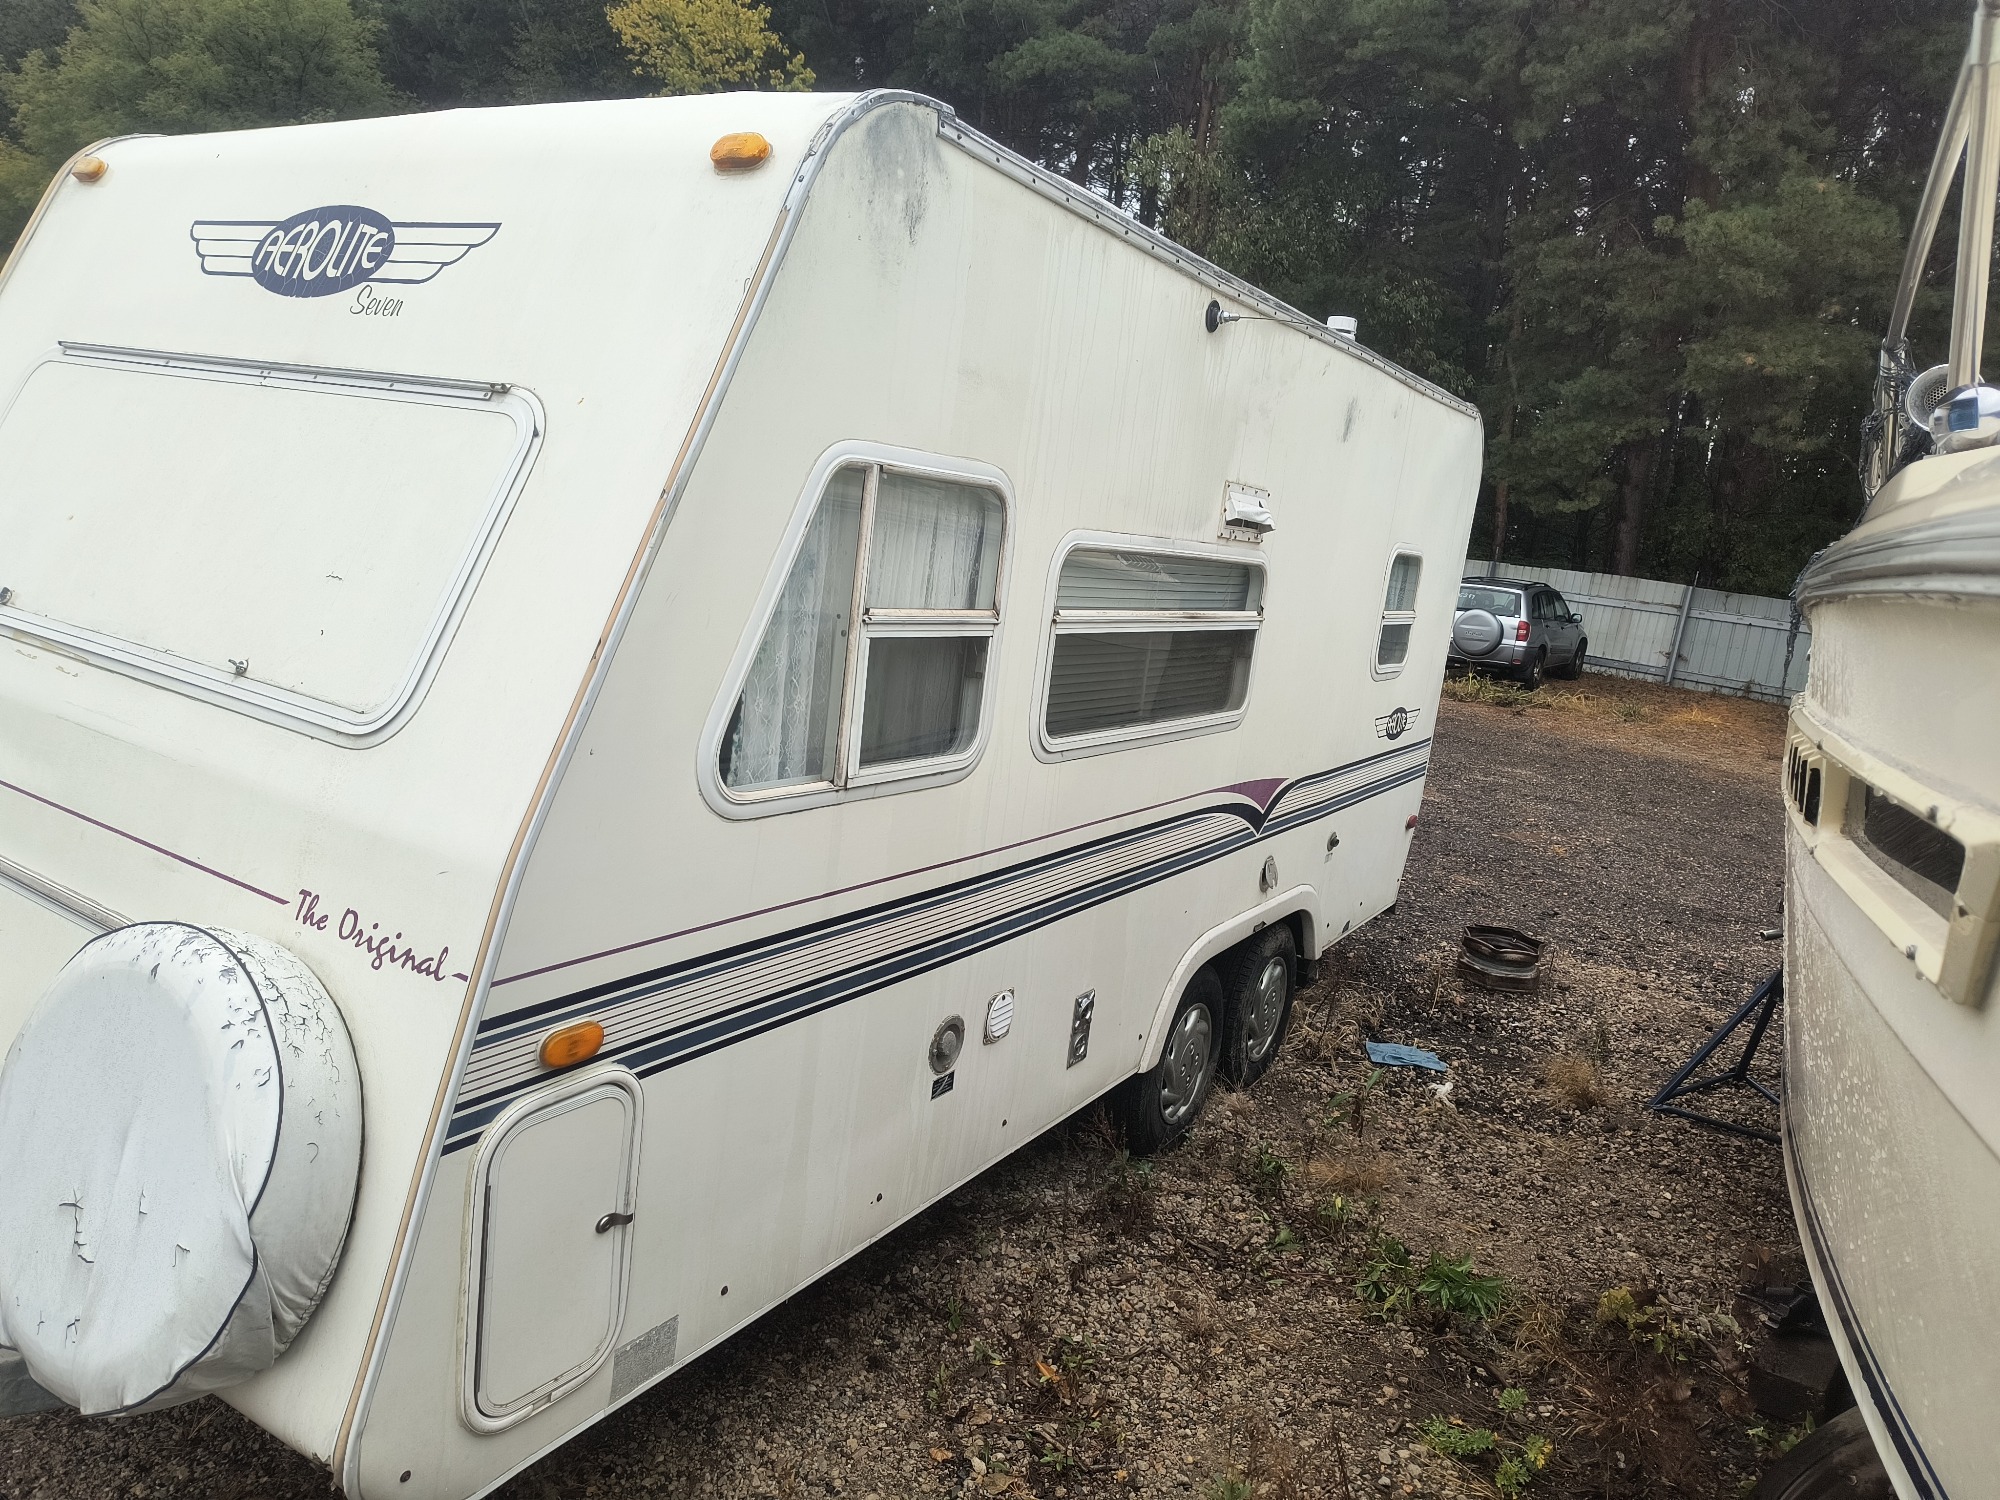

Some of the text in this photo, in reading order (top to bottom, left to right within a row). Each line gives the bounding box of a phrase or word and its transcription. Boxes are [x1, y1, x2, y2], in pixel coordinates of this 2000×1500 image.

[256, 219, 389, 281] AEROLITE
[349, 284, 404, 317] Seven
[295, 888, 449, 981] The Original
